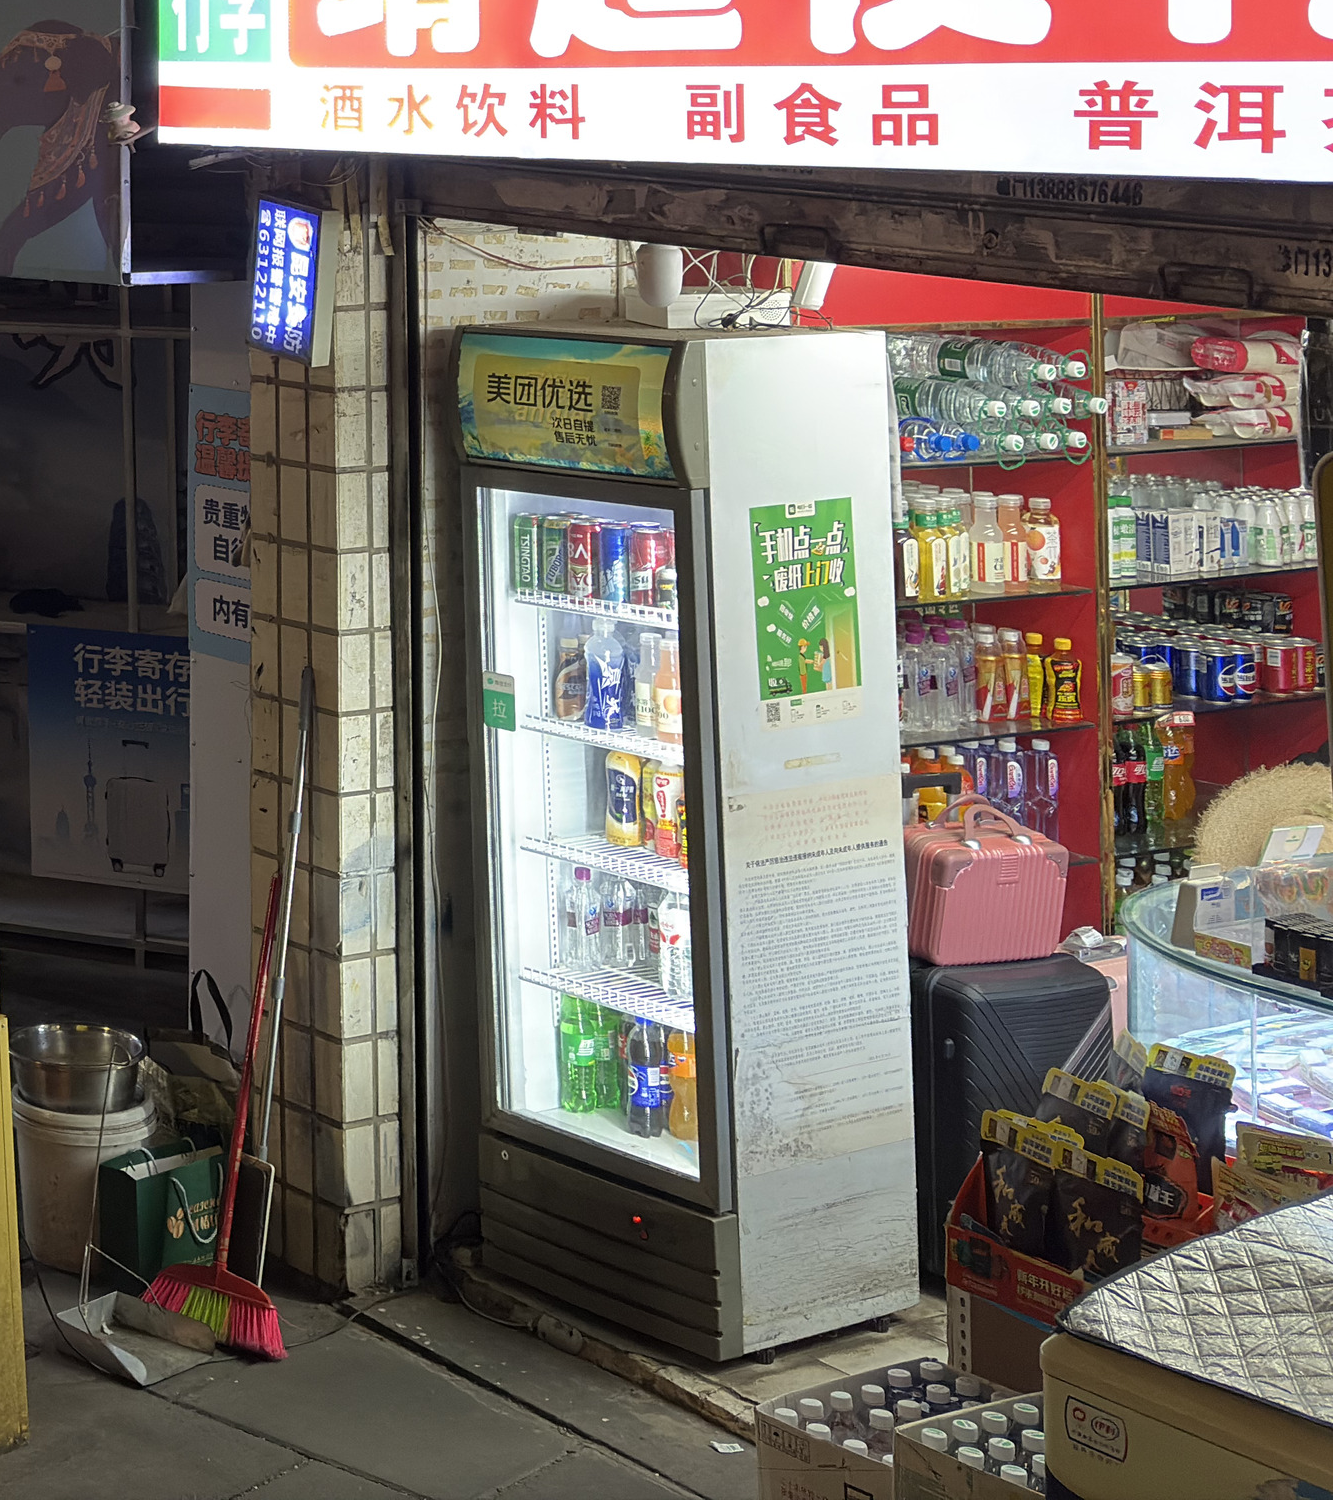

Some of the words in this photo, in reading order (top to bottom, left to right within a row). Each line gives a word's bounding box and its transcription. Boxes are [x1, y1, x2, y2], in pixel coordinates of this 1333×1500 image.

[319, 82, 587, 141] 酒水饮料
[684, 82, 941, 147] 副食品
[1073, 81, 1333, 154] 普洱
[486, 372, 594, 414] 美团优选
[551, 416, 597, 433] 次日自提
[553, 430, 599, 447] 售后无忧
[520, 534, 531, 583] TSINGTAO
[758, 520, 846, 565] 手机点一点
[774, 557, 845, 593] 废纸上门收
[72, 642, 190, 682] 行李寄存
[73, 677, 190, 718] 轻装出行
[492, 698, 508, 719] 拉
